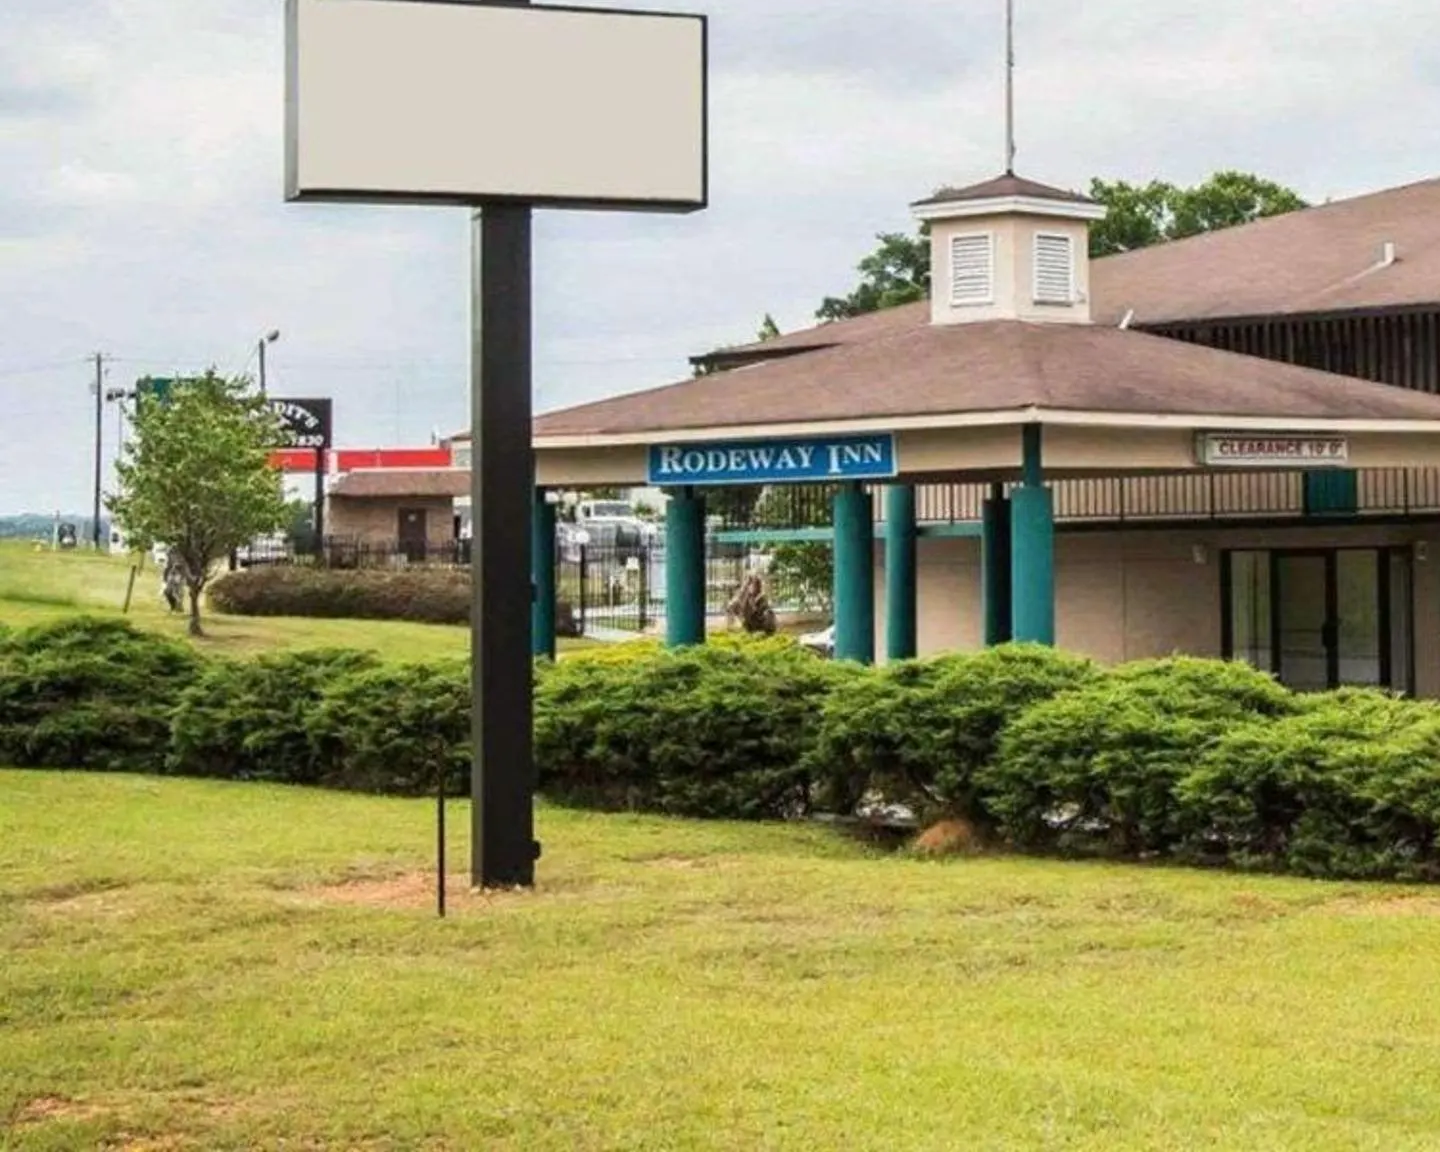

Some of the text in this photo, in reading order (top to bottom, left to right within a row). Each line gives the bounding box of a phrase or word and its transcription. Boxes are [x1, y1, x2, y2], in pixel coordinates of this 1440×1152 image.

[659, 442, 883, 474] RODEWAY INN
[1219, 439, 1302, 456] CLEARANCE
